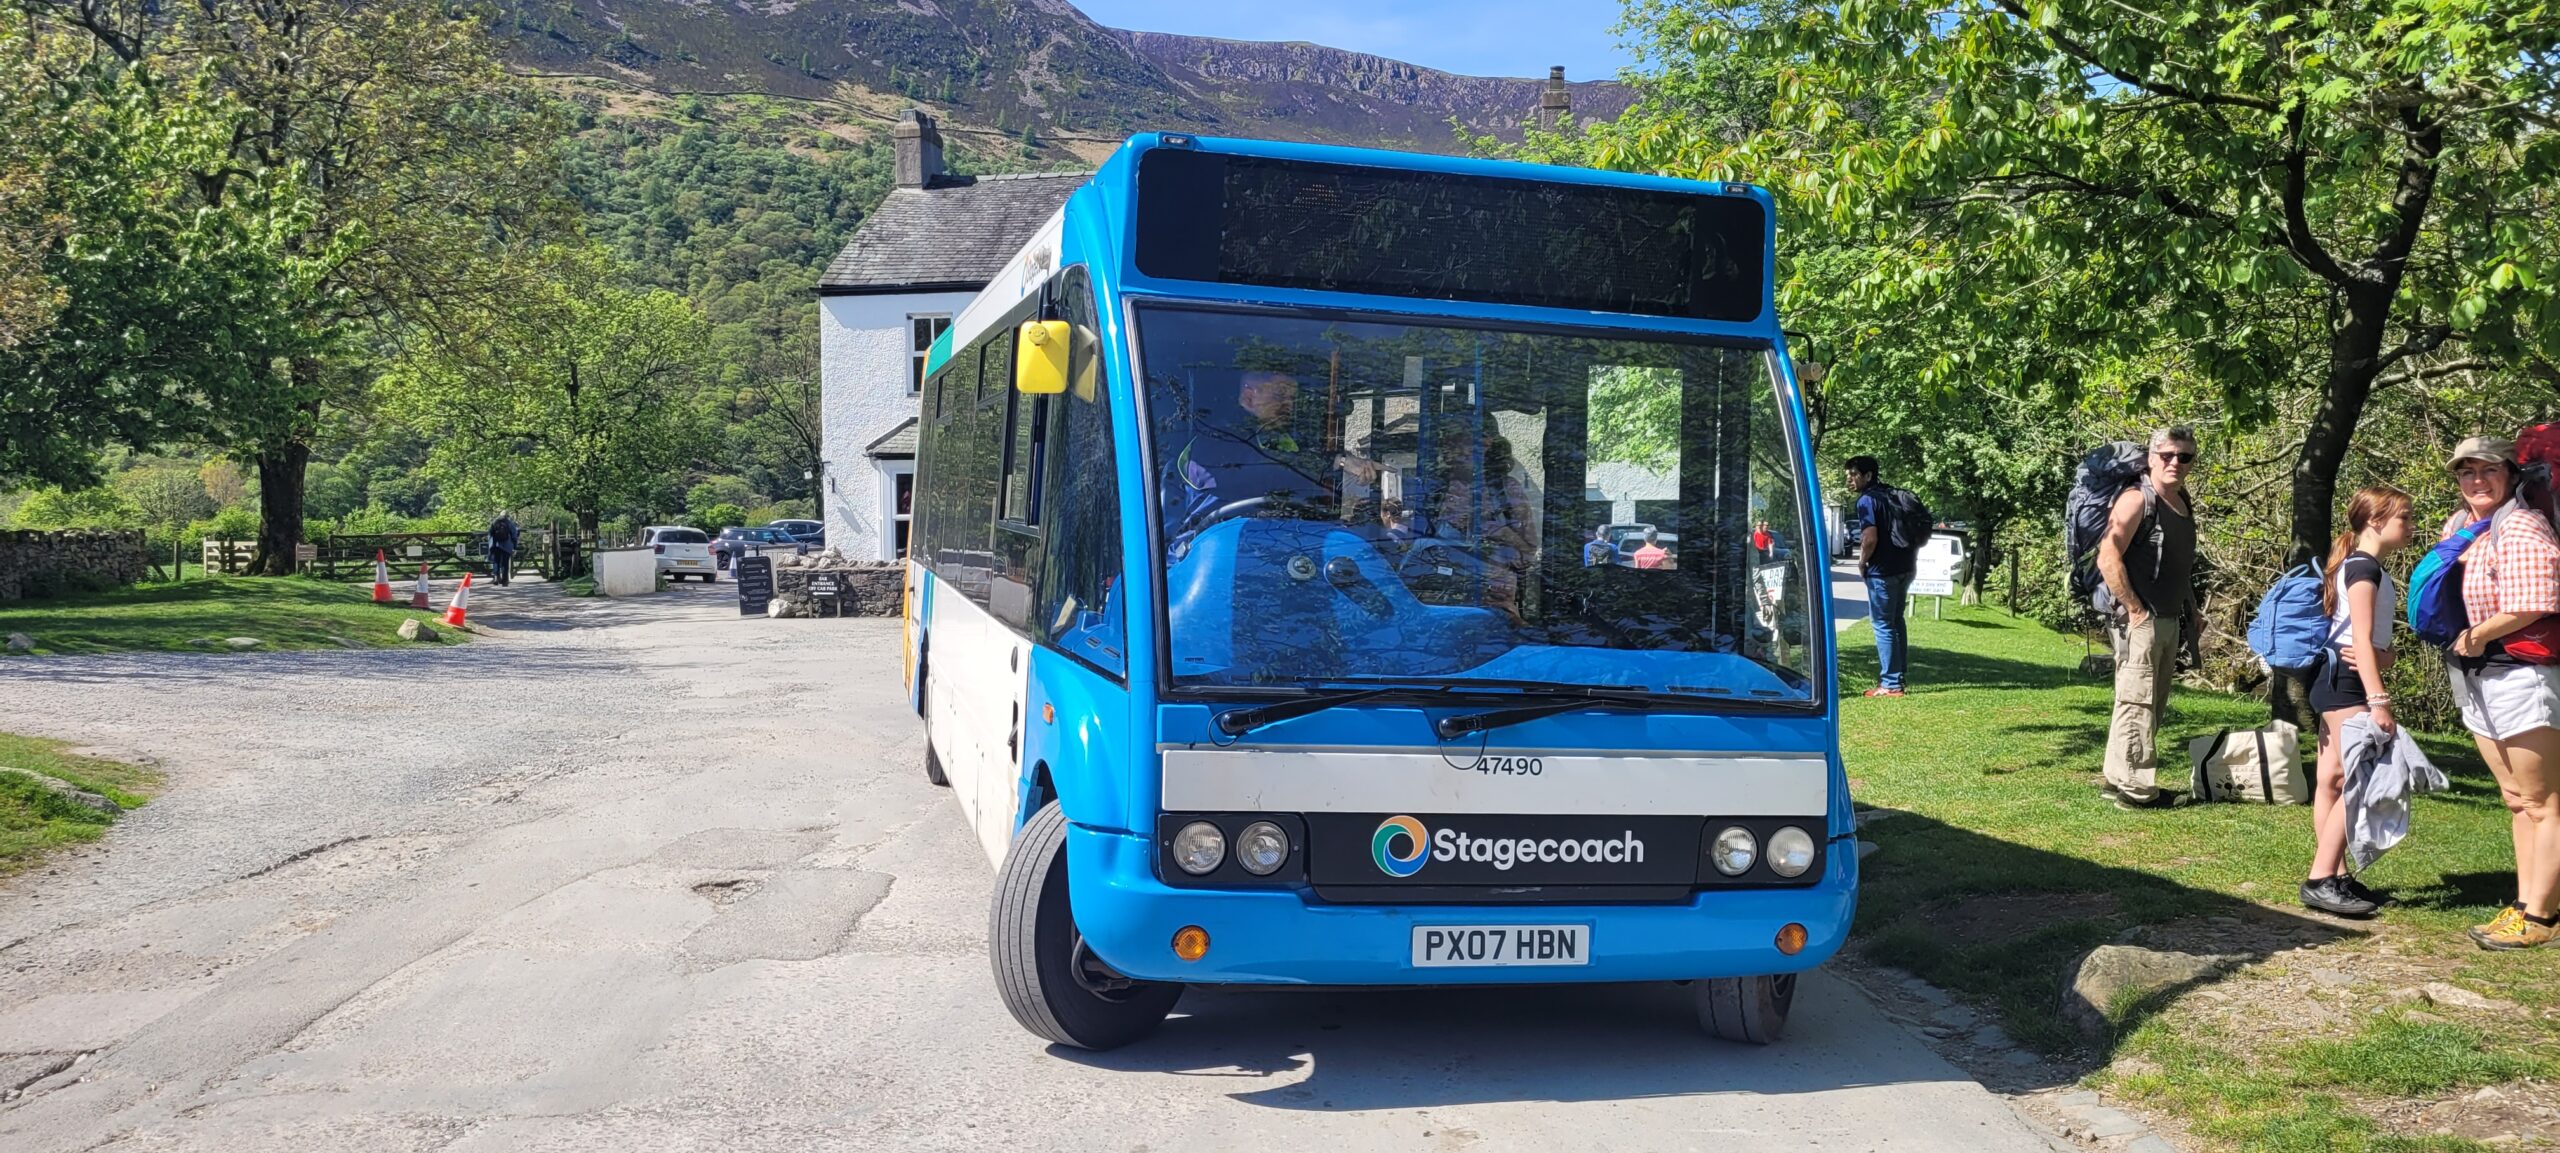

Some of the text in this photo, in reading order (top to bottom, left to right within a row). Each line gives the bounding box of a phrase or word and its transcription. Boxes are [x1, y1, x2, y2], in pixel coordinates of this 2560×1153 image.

[1477, 757, 1543, 775] 47490
[1433, 828, 1644, 870] Stagecoach
[1426, 929, 1576, 960] PX07 HBN
